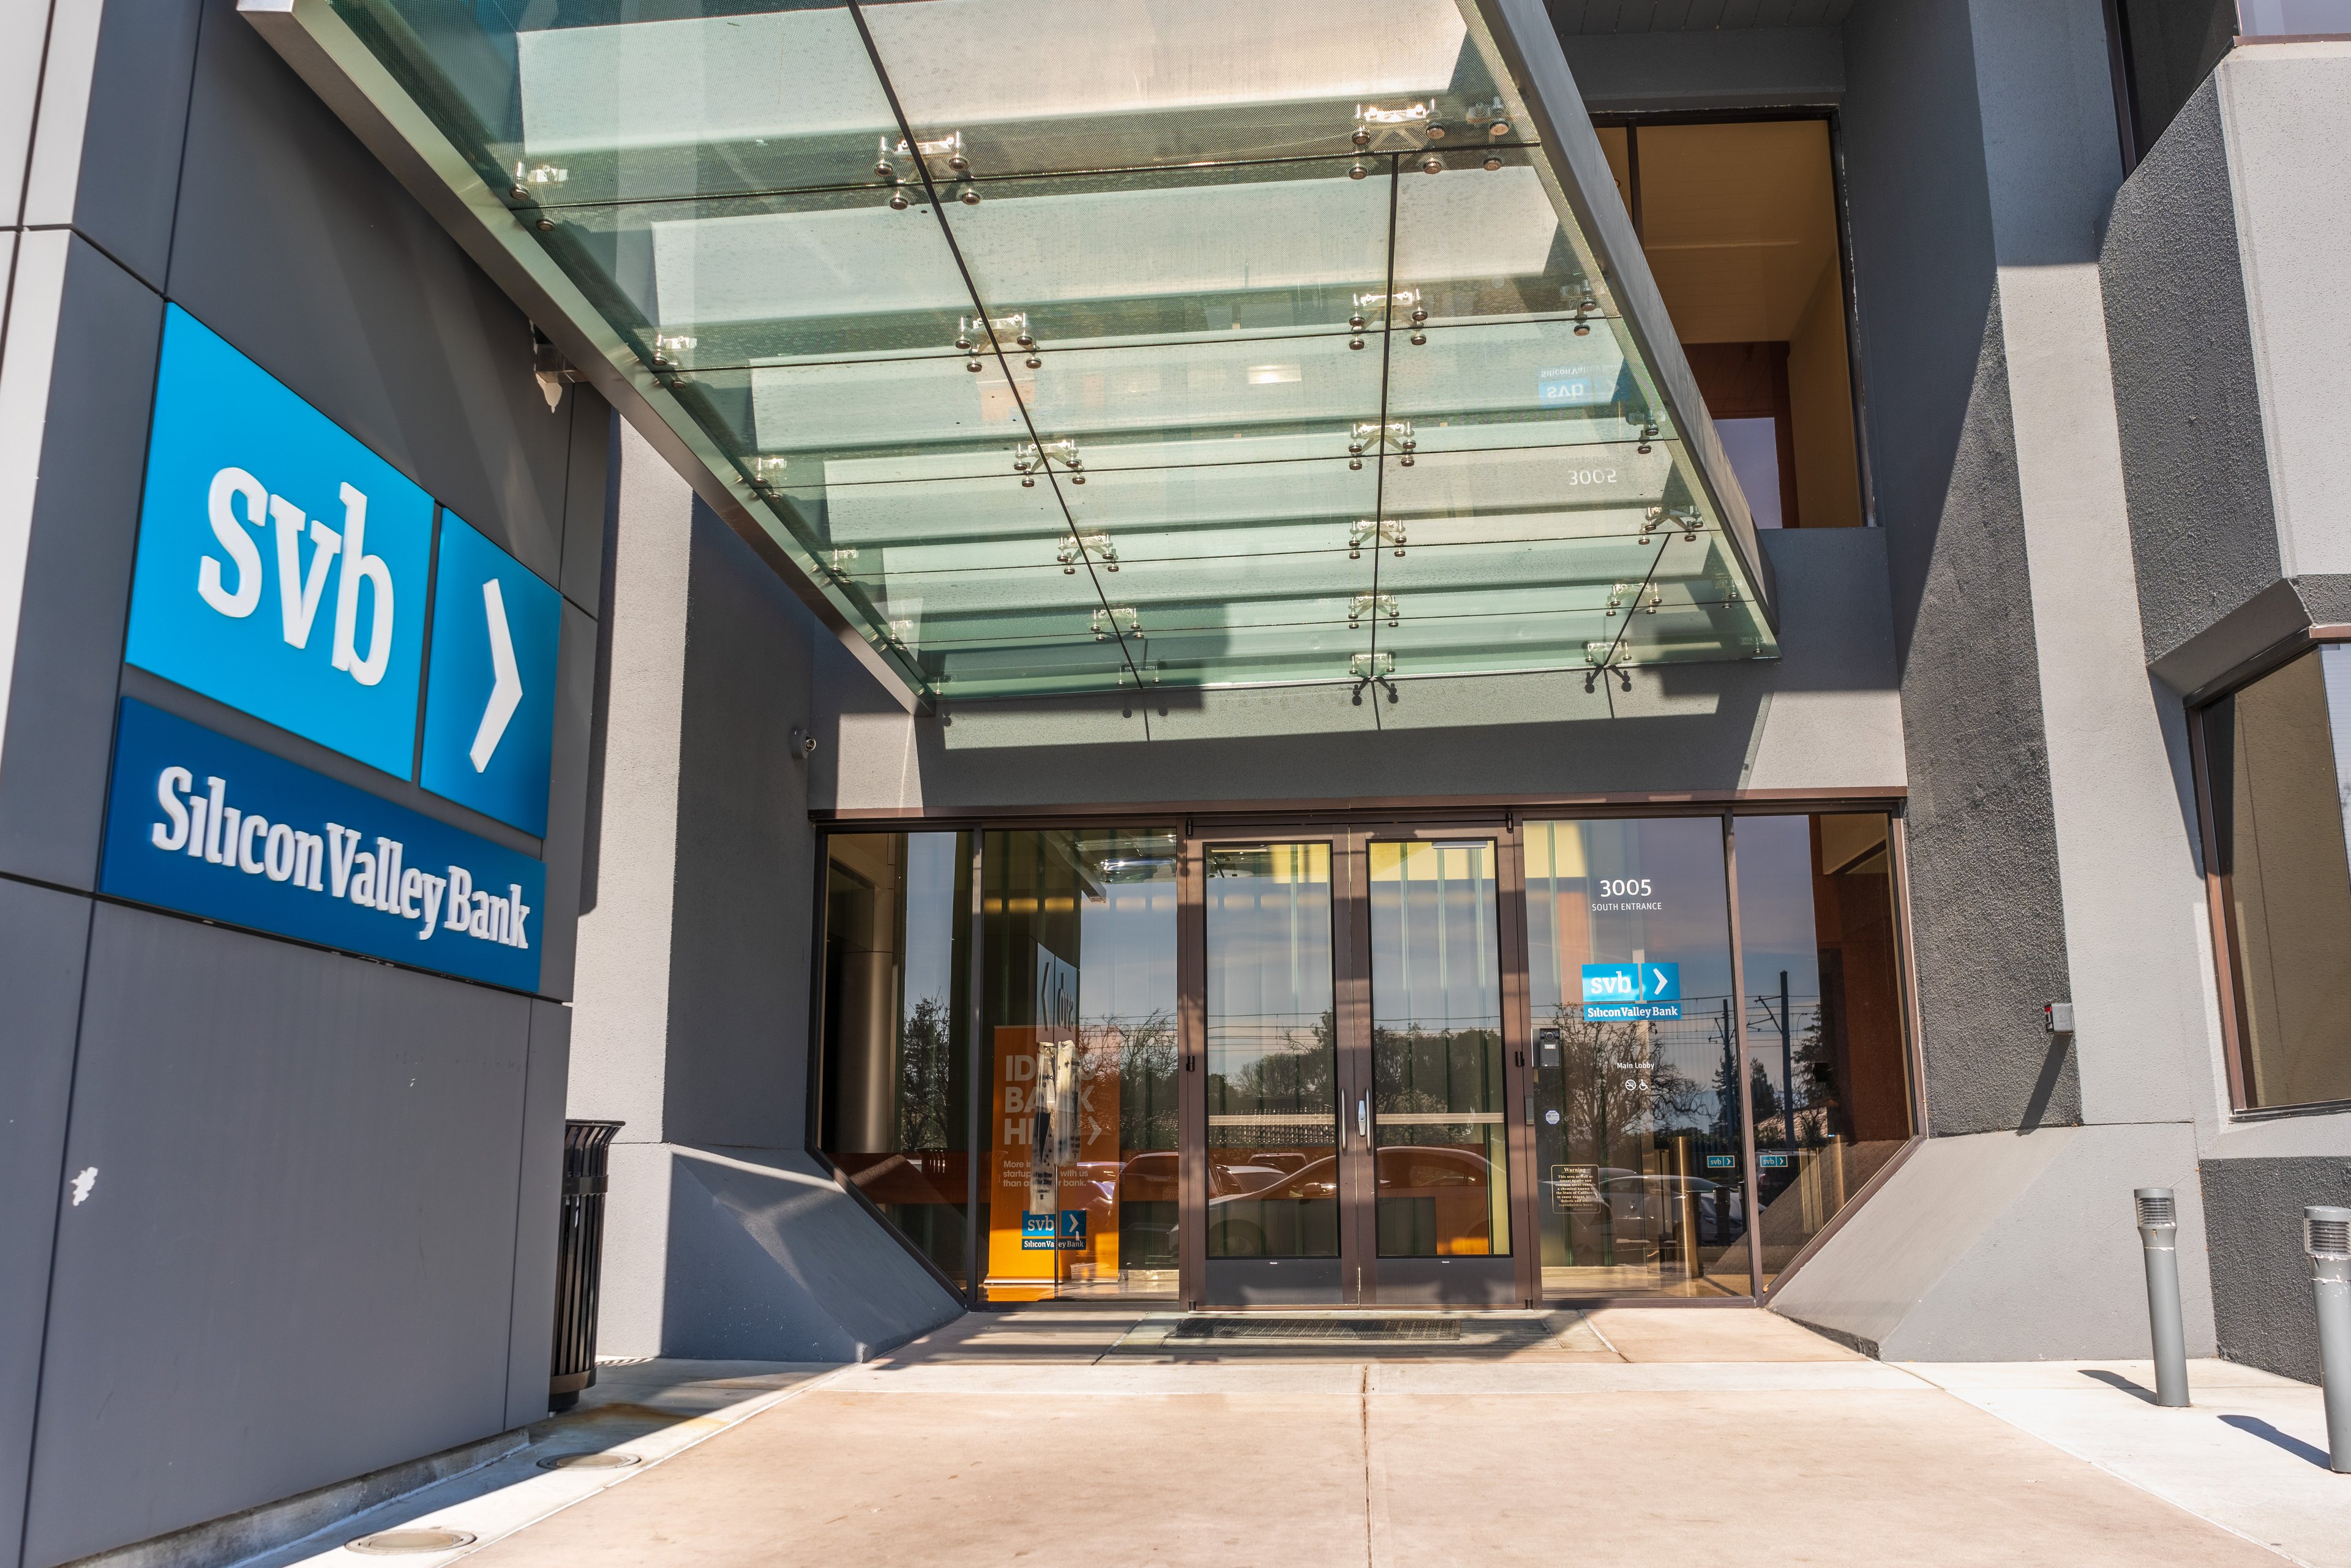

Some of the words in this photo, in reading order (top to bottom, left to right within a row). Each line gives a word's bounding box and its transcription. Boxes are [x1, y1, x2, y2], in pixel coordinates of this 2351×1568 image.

[198, 467, 394, 686] svb
[1600, 879, 1652, 898] 3005
[443, 865, 531, 948] Bank
[1621, 902, 1662, 910] ENTRANCE
[1591, 970, 1632, 994] svb
[1652, 1006, 1678, 1016] Bank
[1027, 1215, 1054, 1232] svb
[1046, 1240, 1067, 1248] Vaey
